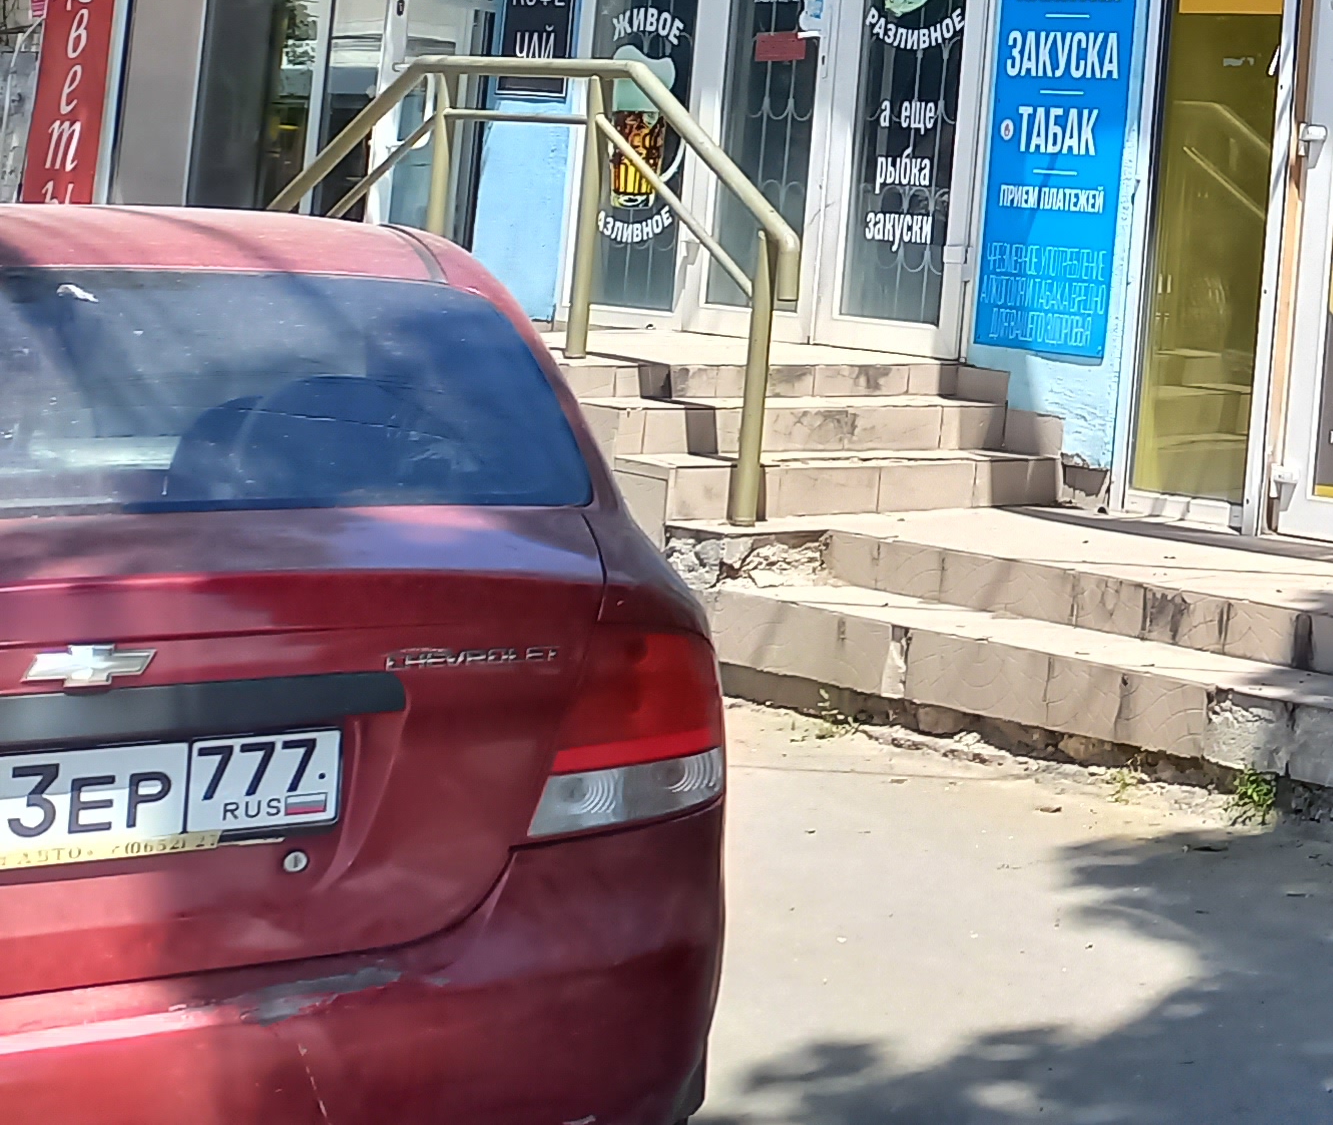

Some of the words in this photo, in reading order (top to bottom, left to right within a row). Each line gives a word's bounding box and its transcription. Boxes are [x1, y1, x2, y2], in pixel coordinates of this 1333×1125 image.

[612, 7, 684, 46] ЖИВОЕ
[865, 6, 966, 51] РАЗЛИВНОЕ
[1006, 30, 1119, 80] ЗАКУСКА
[880, 100, 891, 127] а
[901, 99, 936, 135] еще
[1018, 105, 1099, 156] ТАБАК
[875, 147, 932, 194] рыбка
[999, 184, 1039, 210] ПРИЕМ
[1040, 185, 1105, 214] ПЛАТЕЖЕЙ
[597, 205, 674, 244] АЗЛИВНОЕ
[865, 212, 933, 252] закуски
[386, 646, 560, 672] CHEVROLET
[197, 737, 317, 802] 777
[222, 797, 282, 822] RUS
